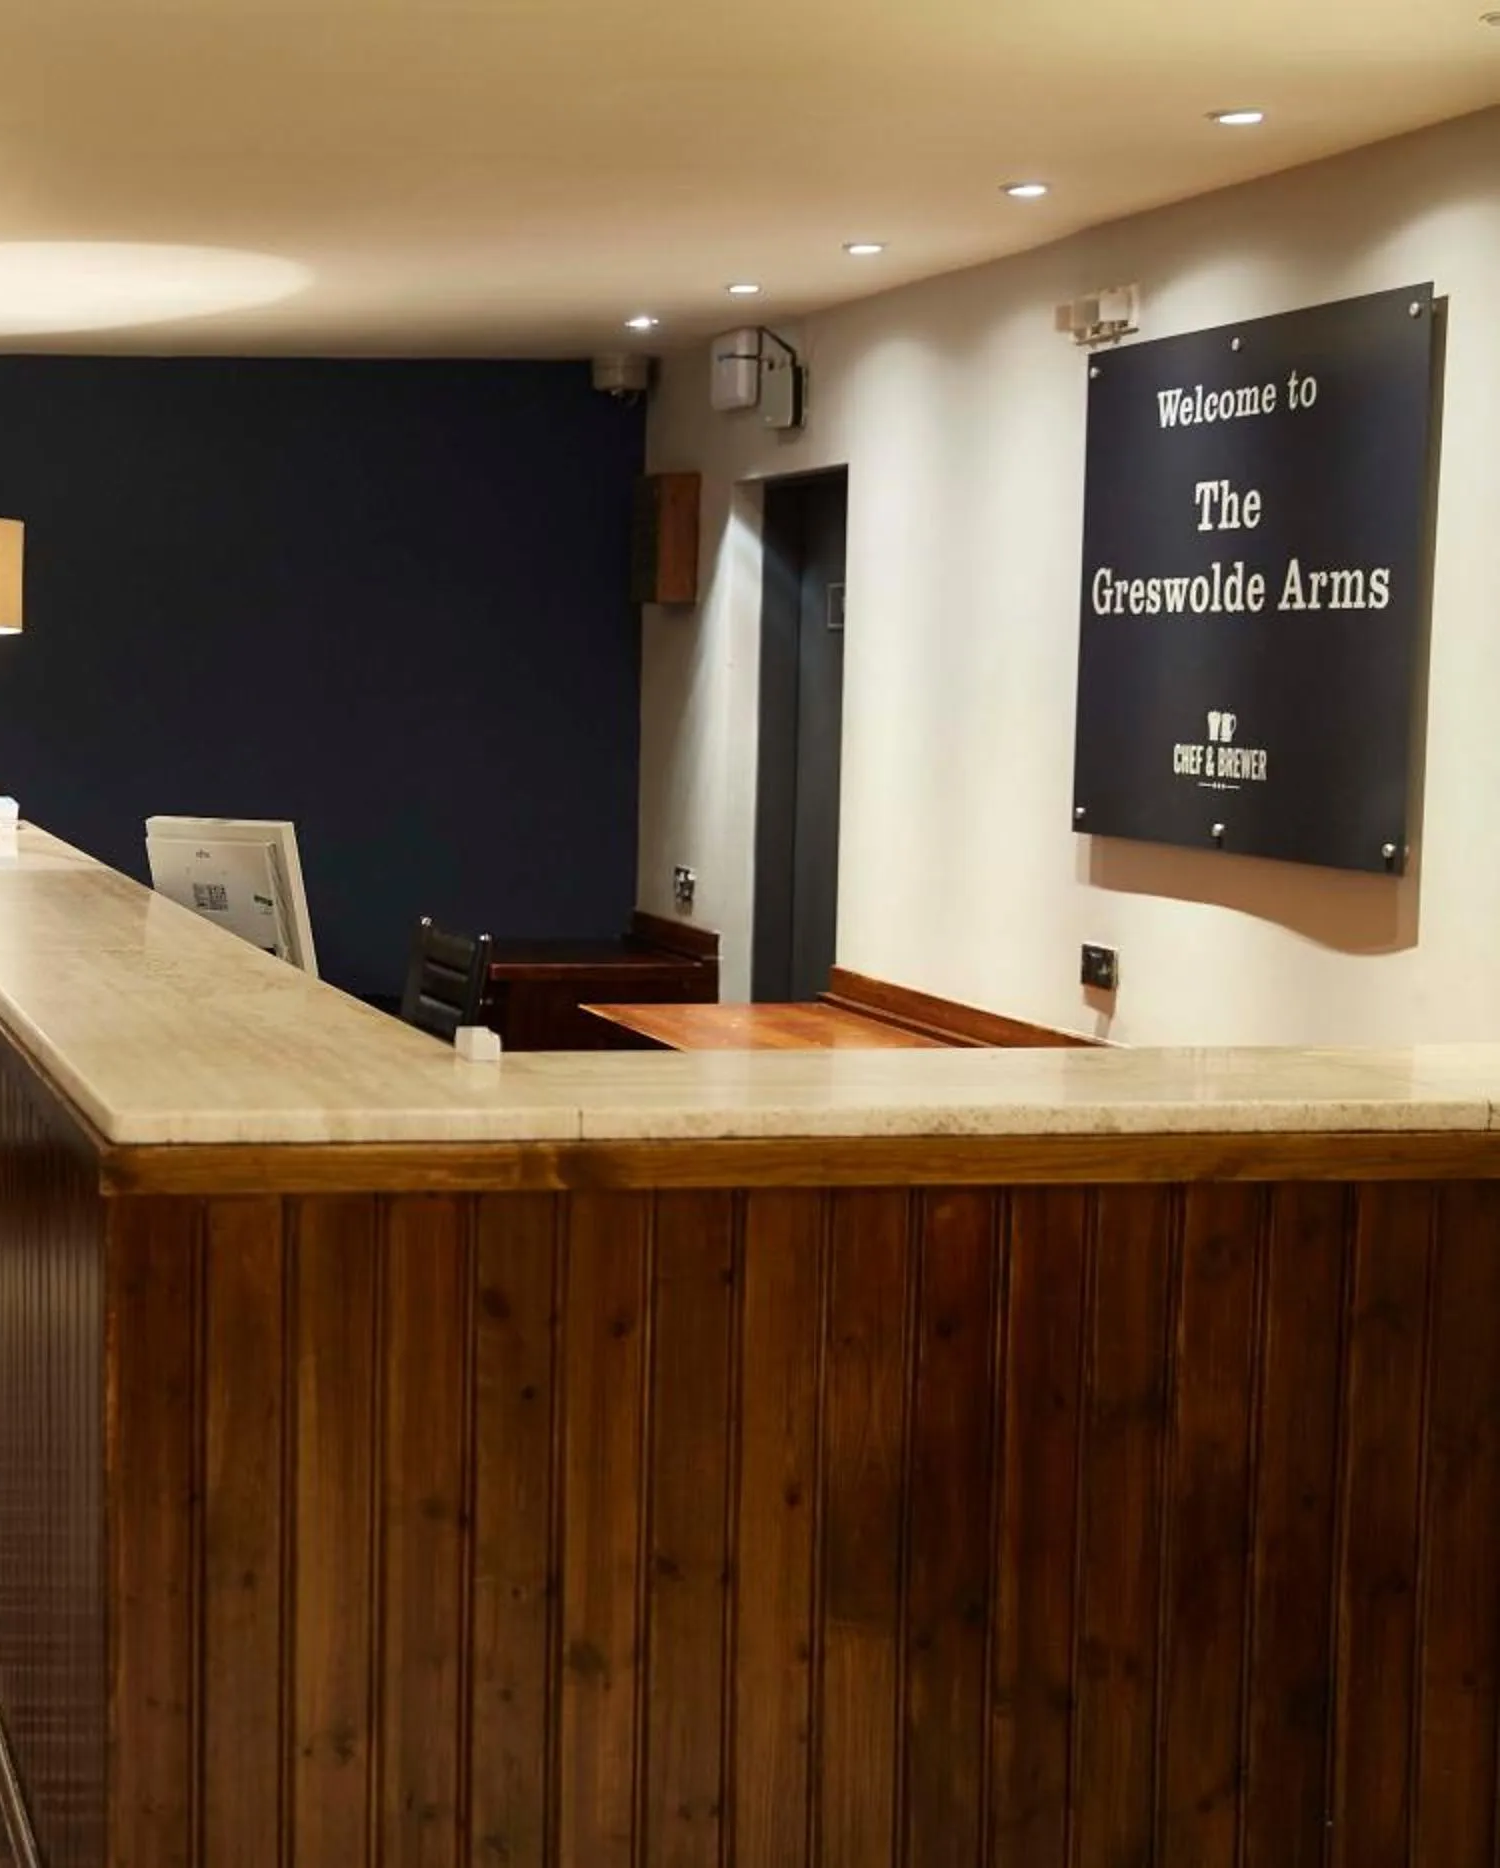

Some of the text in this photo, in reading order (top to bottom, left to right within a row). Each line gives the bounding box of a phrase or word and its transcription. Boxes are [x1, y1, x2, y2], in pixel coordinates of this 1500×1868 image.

[1157, 370, 1317, 429] Welcome to
[1194, 479, 1262, 533] The
[1091, 557, 1391, 616] Greswolde Arms
[1173, 743, 1267, 781] CHEF & BREWER
